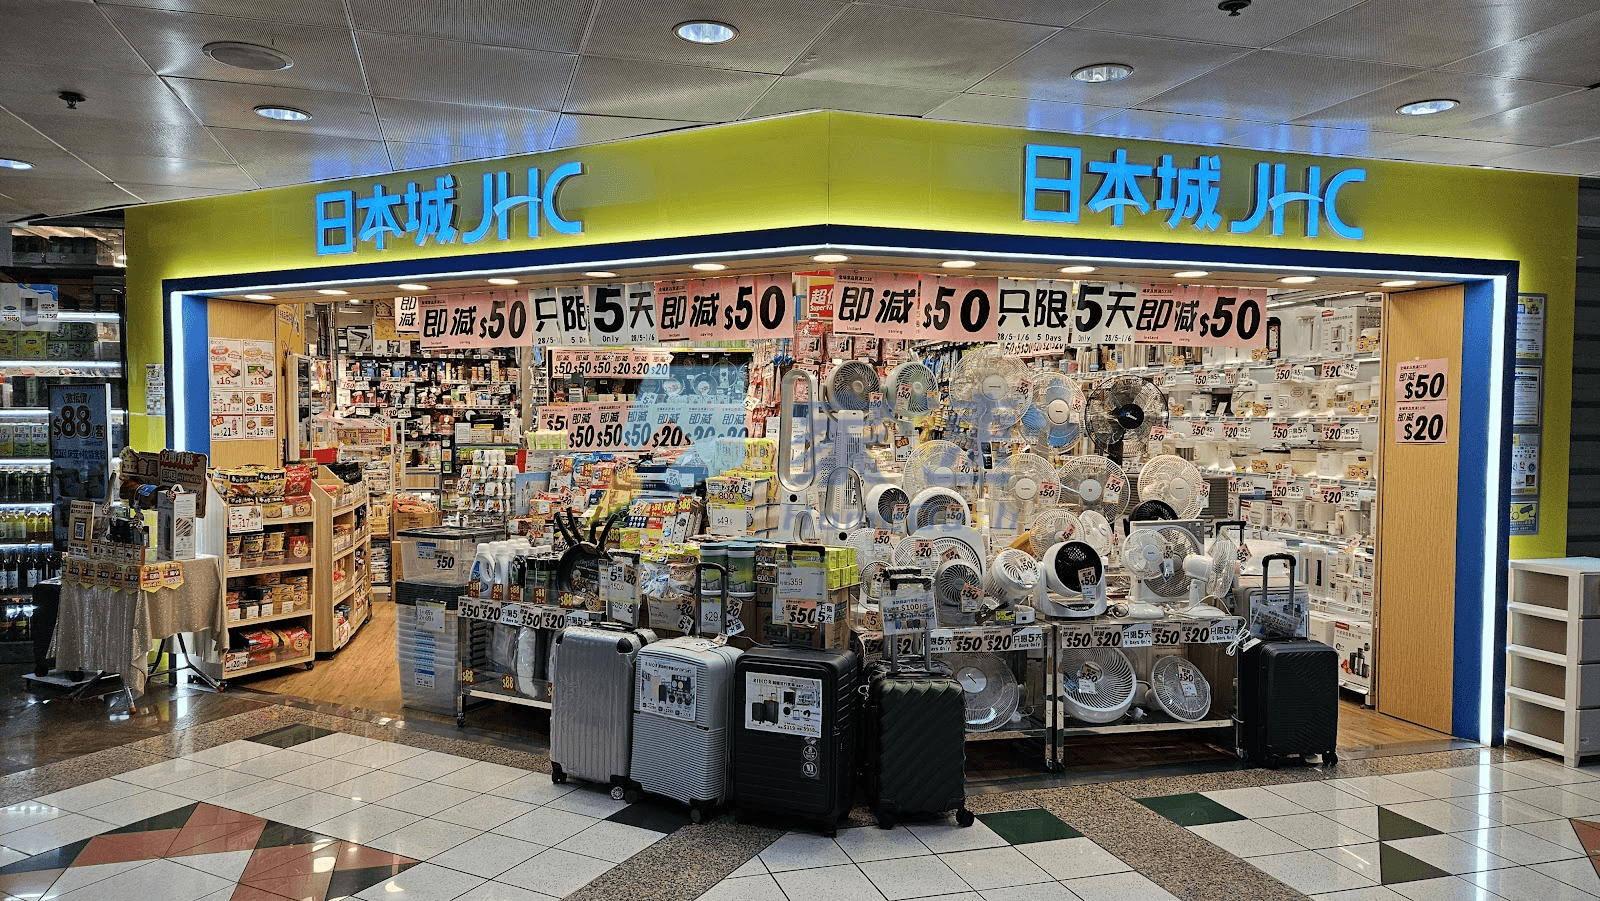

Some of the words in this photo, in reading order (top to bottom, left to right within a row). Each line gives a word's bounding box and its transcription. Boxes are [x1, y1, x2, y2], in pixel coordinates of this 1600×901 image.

[1024, 144, 1222, 230] 日本城
[1230, 163, 1366, 239] JHC
[316, 174, 458, 255] 日本城
[462, 162, 583, 244] JHC
[661, 292, 720, 329] 即減
[724, 285, 786, 331] $50
[838, 286, 916, 323] 即減
[922, 286, 990, 332] $50
[423, 305, 477, 337] 即減
[479, 300, 527, 339] $50
[1136, 299, 1200, 332] 即減
[1200, 296, 1261, 340] $50
[602, 335, 620, 343] Only
[997, 333, 1030, 341] 28/5-1/6
[1045, 333, 1062, 342] Days
[1104, 334, 1132, 342] 28/5-1/6
[554, 361, 572, 374] $50
[593, 361, 611, 374] $50
[613, 362, 631, 375] $20
[632, 362, 650, 375] $20
[651, 363, 668, 375] $20
[1276, 369, 1290, 380] $50
[1404, 372, 1445, 399] $50
[547, 415, 568, 431] $5
[569, 425, 595, 448] $50
[596, 423, 622, 447] $50
[624, 422, 651, 446] $50
[652, 425, 683, 448] $20
[1224, 427, 1238, 438] $20
[1273, 428, 1288, 439] $50
[1324, 428, 1341, 440] $20
[1404, 414, 1443, 441] $20
[1039, 489, 1055, 498] $50
[1105, 482, 1121, 493] $50
[1323, 490, 1342, 504] $20
[874, 535, 889, 545] $50
[915, 547, 932, 558] $20
[437, 556, 455, 569] $50
[1081, 575, 1096, 585] $50
[461, 605, 480, 618] $50
[482, 606, 501, 621] $20
[522, 612, 540, 628] $50
[545, 614, 565, 629] $20
[987, 634, 1012, 651] $20
[1066, 632, 1092, 648] $50
[1096, 631, 1121, 647] $20
[1154, 630, 1179, 645] $50
[1185, 627, 1210, 642] $20
[956, 636, 983, 652] $50
[502, 674, 513, 689] $88
